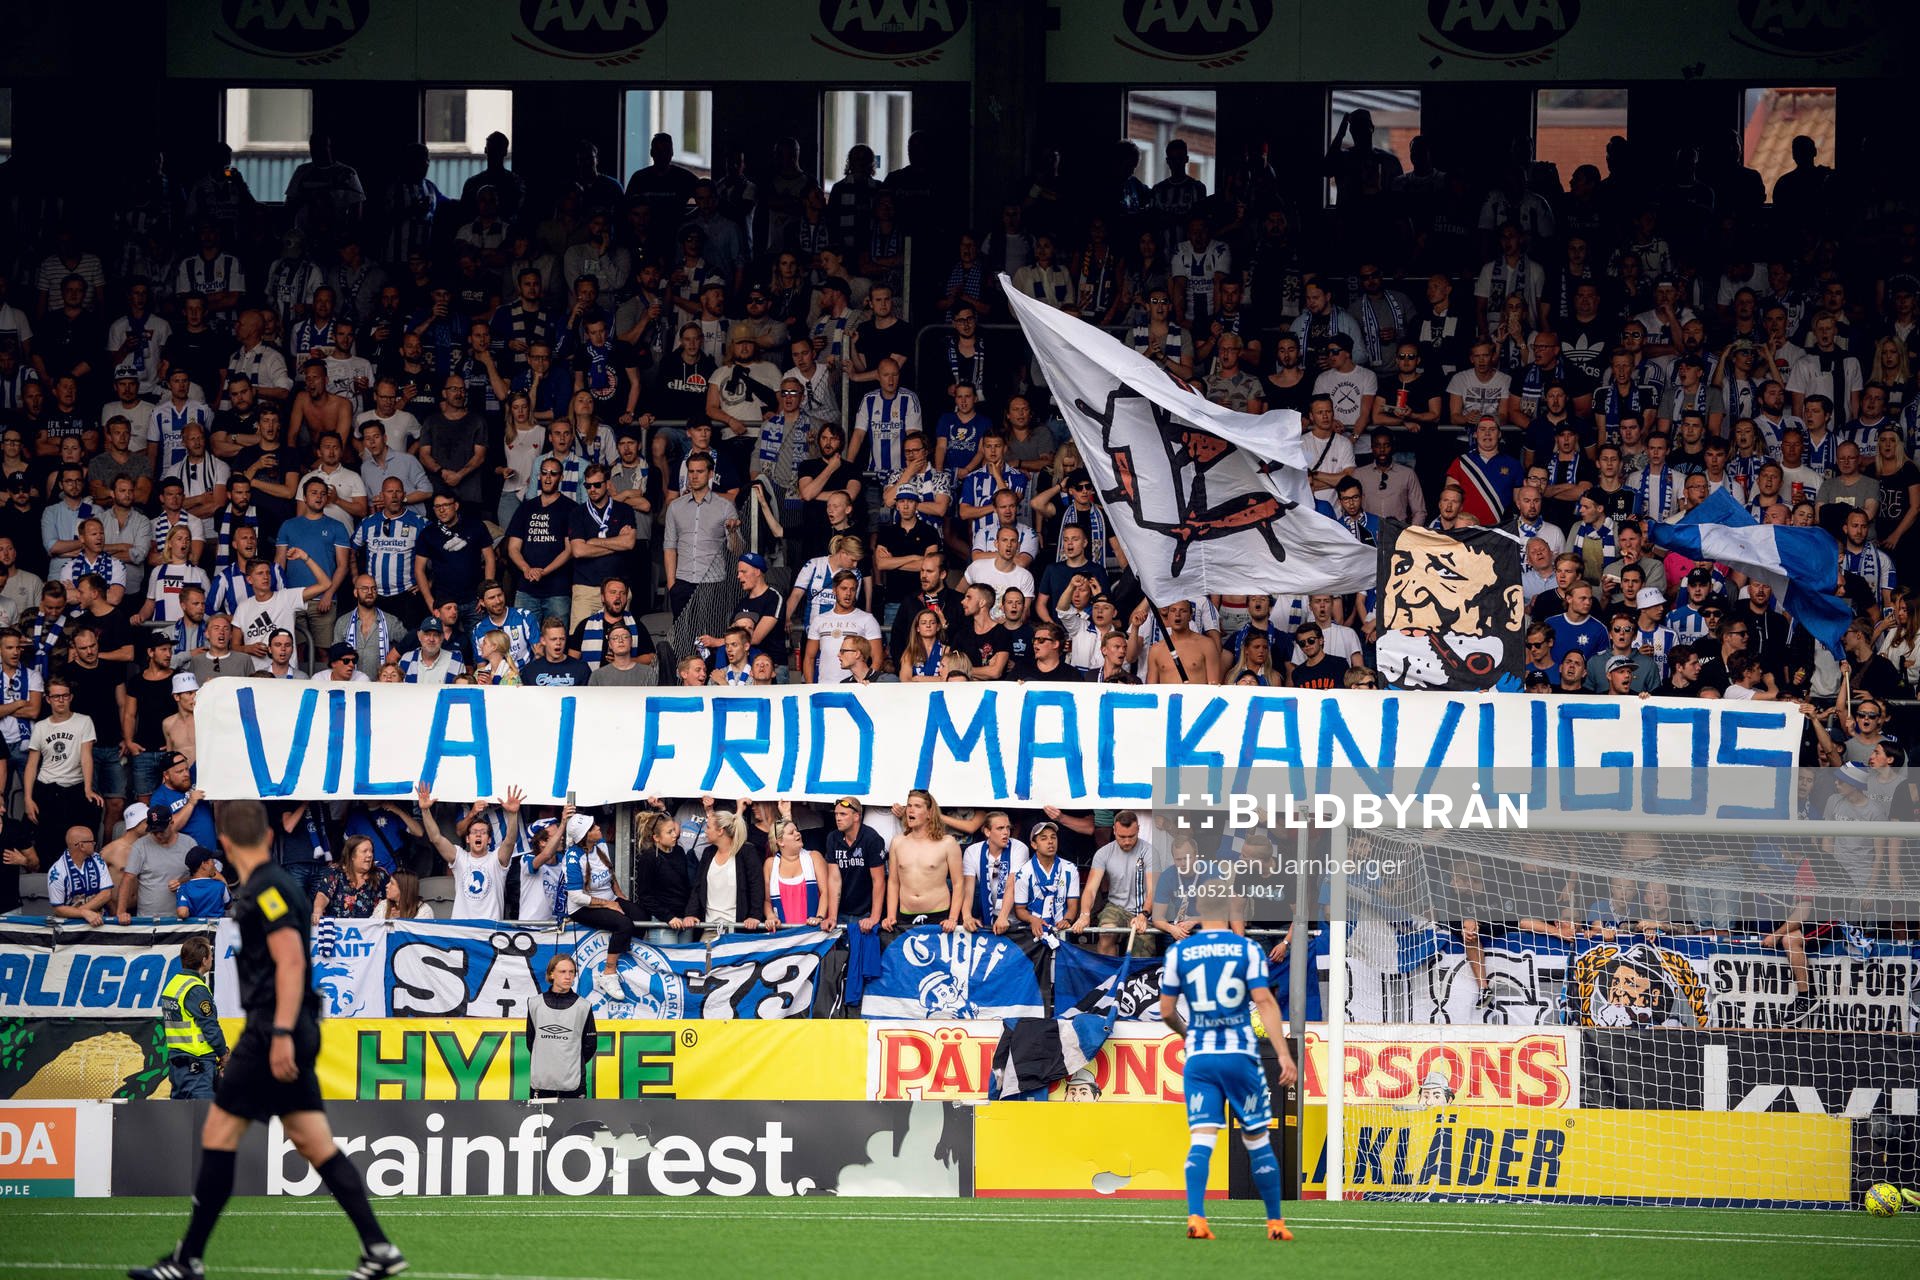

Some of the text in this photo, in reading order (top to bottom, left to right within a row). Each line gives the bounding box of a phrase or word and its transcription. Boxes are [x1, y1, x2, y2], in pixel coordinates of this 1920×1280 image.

[534, 0, 655, 31] AXA
[833, 0, 953, 31] AXA
[1137, 0, 1259, 32] AXA
[1442, 0, 1566, 31] AXA
[372, 538, 407, 548] Prioritet
[247, 623, 277, 639] adidas
[45, 732, 74, 744] MORRIS
[236, 687, 493, 798] VILA
[551, 696, 576, 798] I
[632, 691, 874, 795] FRID
[1182, 944, 1243, 961] SERNEKE
[1185, 960, 1247, 1012] 16
[1851, 958, 1907, 998] FÖR
[1717, 1000, 1746, 1029] DE
[267, 1112, 814, 1197] brainforest.
